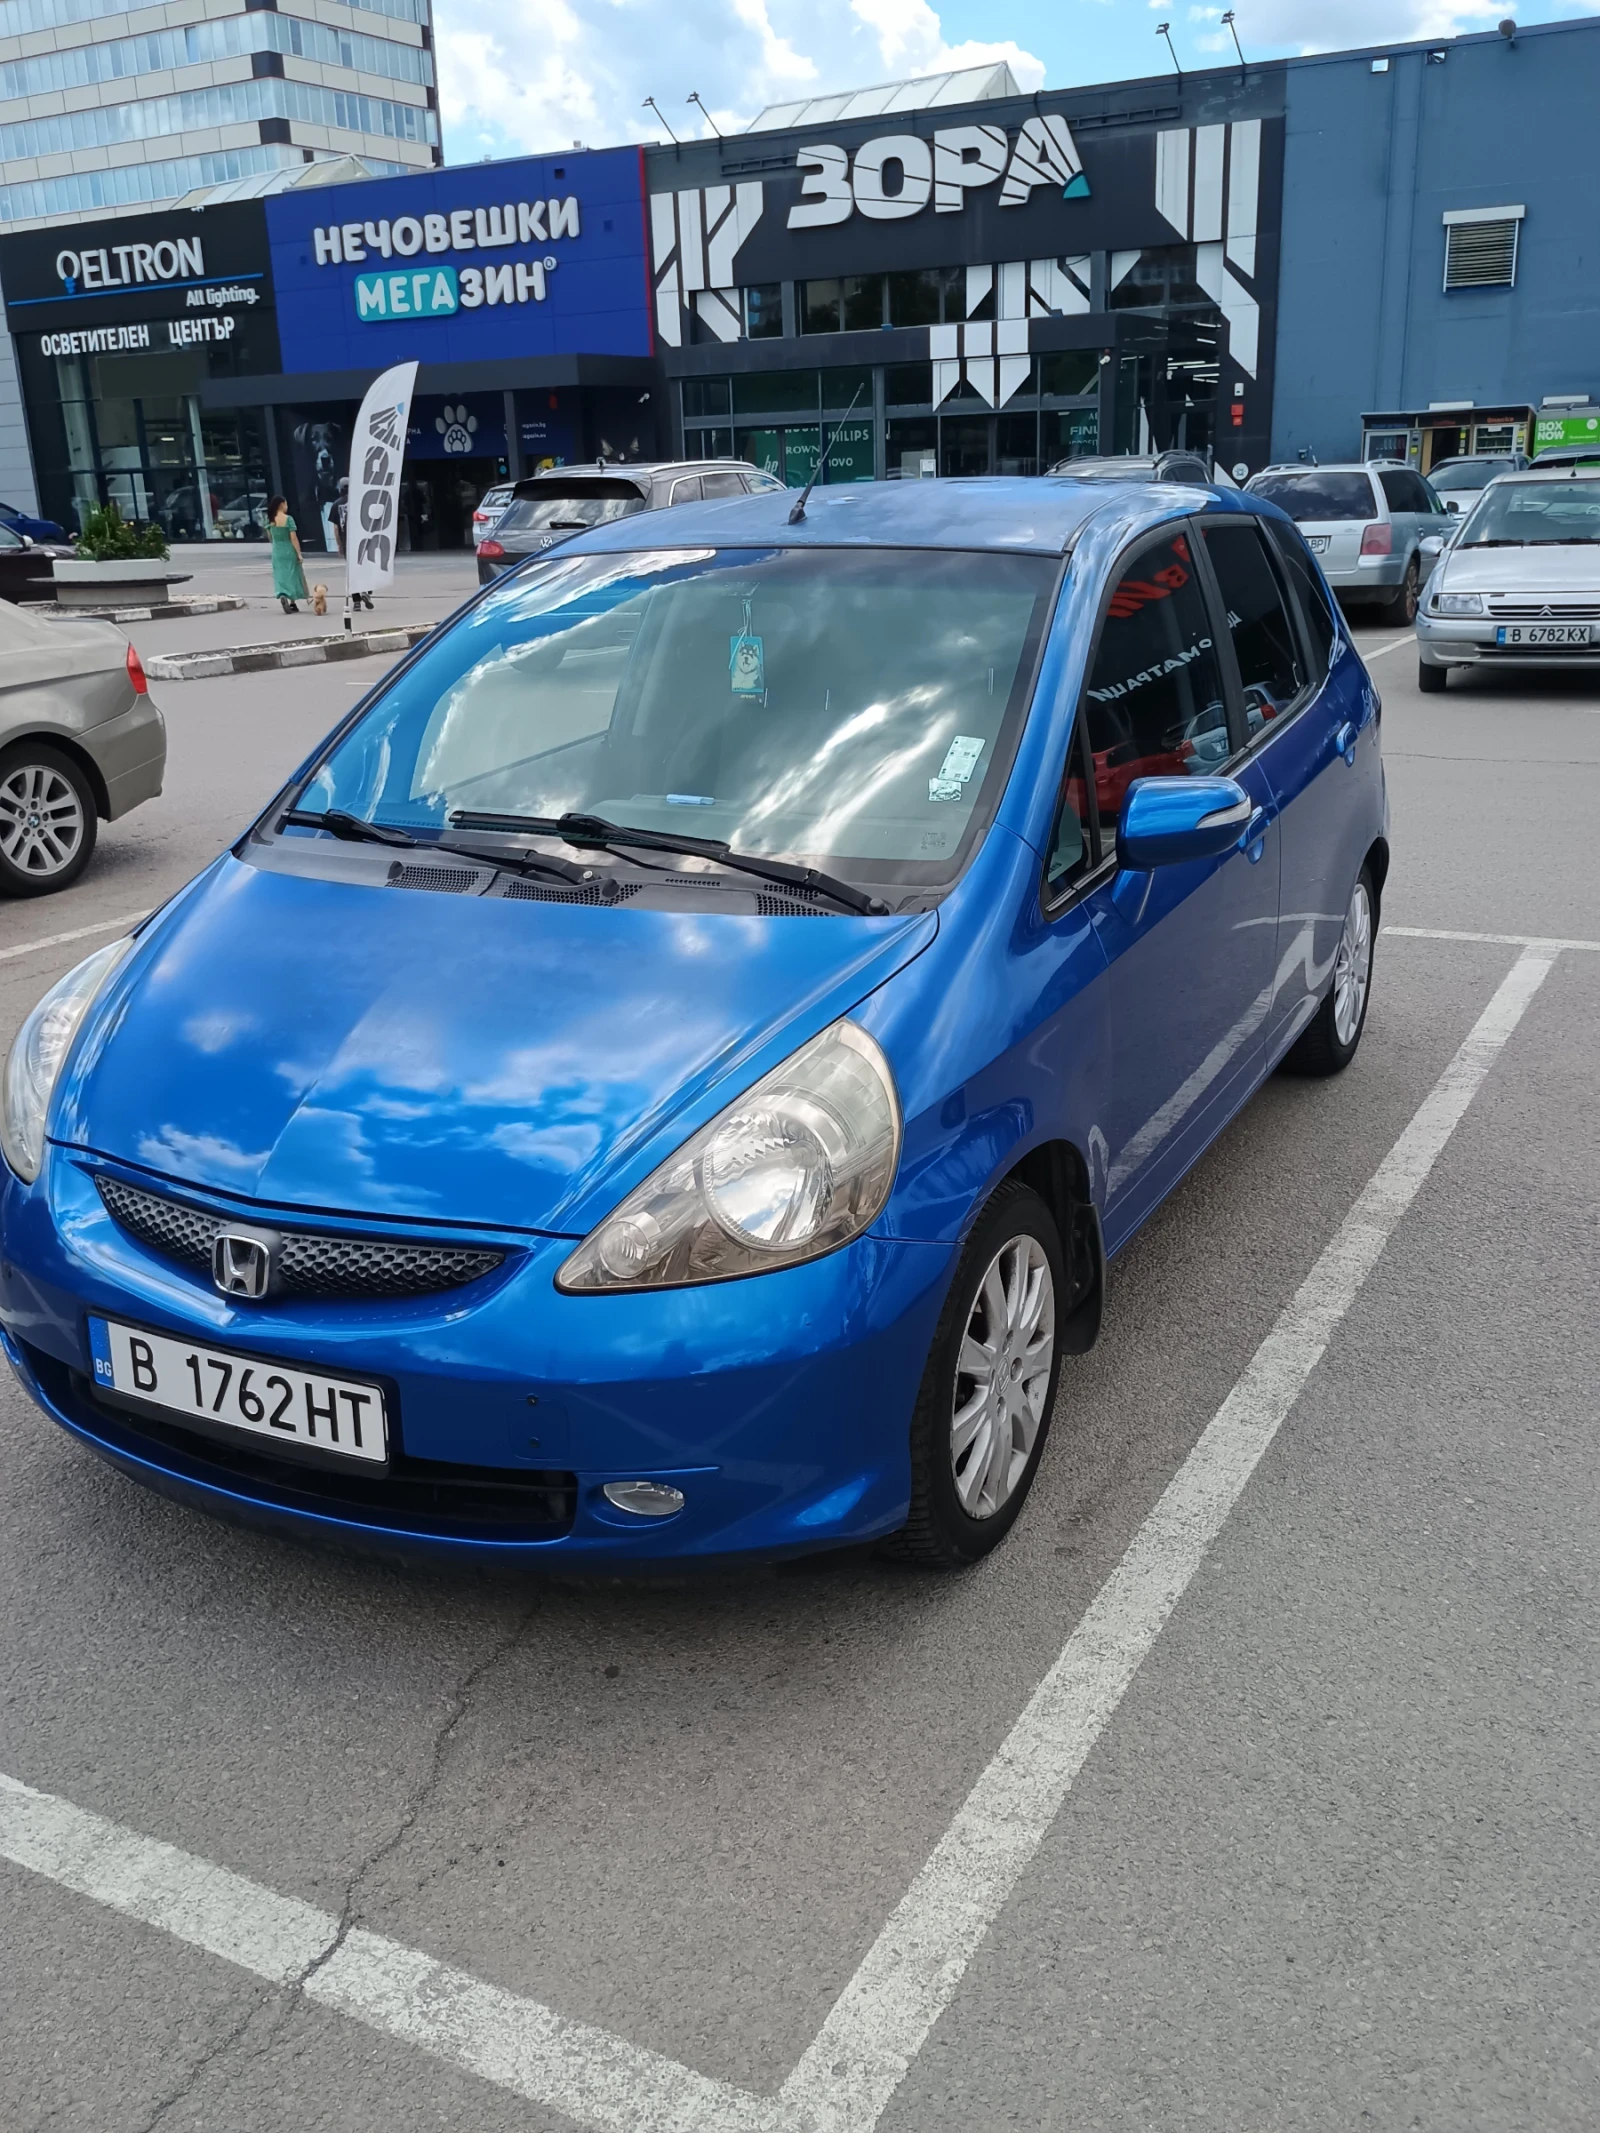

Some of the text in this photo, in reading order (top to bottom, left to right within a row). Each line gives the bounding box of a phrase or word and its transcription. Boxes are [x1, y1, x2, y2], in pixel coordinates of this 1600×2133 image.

[787, 114, 1091, 229] ЗОРА
[313, 196, 580, 266] НЕЧОВЕШКИ
[186, 290, 205, 306] All
[40, 315, 235, 356] ОСВЕТИТЕЛЕН ЦЕНТЪР
[828, 429, 869, 442] HILIPS
[1537, 430, 1565, 441] NOW
[1538, 421, 1563, 431] BOX
[764, 455, 778, 474] hp
[357, 402, 405, 572] ЗОРА
[95, 1357, 112, 1377] BG
[129, 1336, 158, 1393] B
